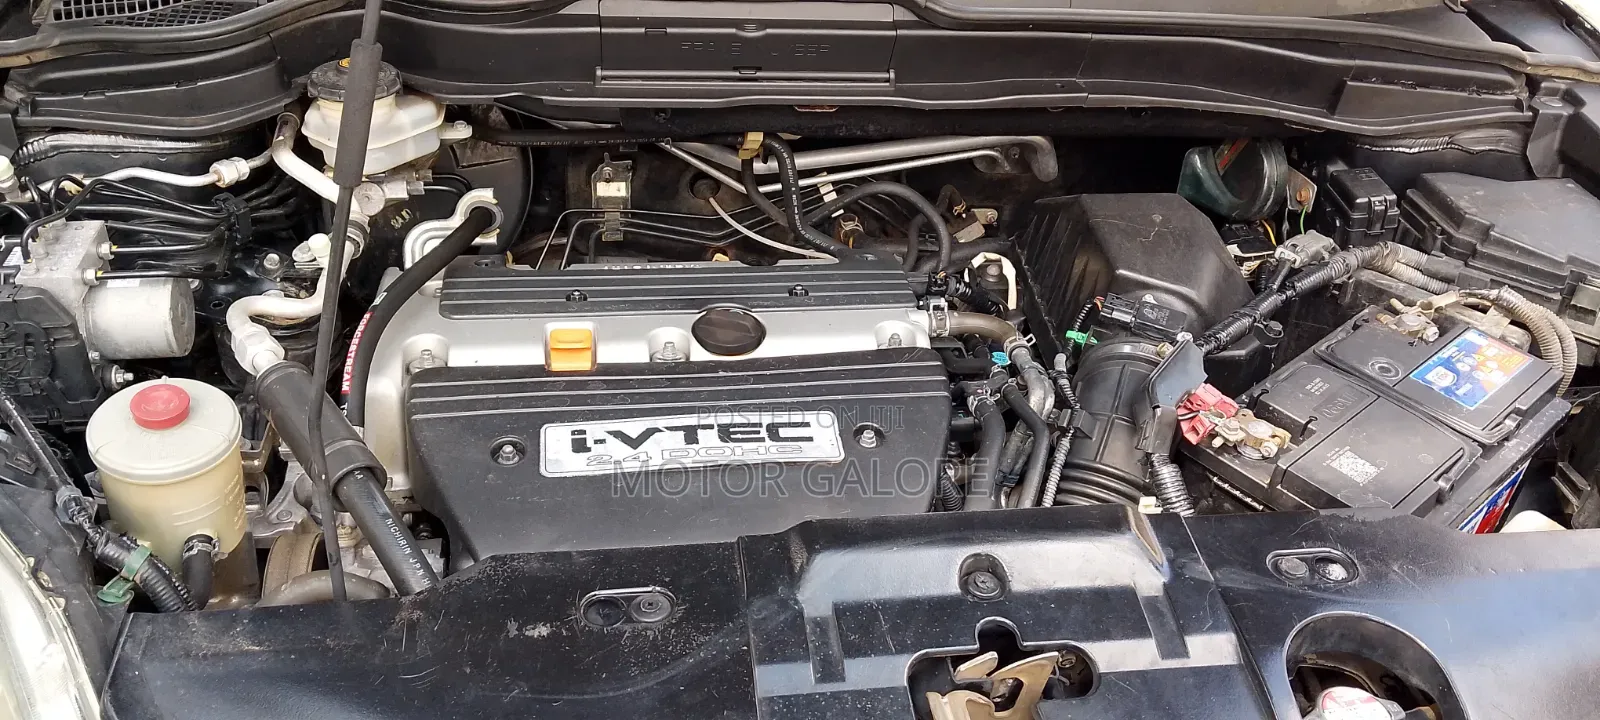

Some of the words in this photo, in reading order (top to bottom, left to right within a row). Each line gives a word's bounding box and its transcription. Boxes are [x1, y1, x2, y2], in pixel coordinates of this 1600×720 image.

[342, 311, 371, 391] FORCESTREAM
[571, 421, 814, 454] i-VTEC
[586, 451, 653, 467] 2.4
[661, 445, 803, 461] DOHC
[385, 518, 413, 555] NICHIRIN
